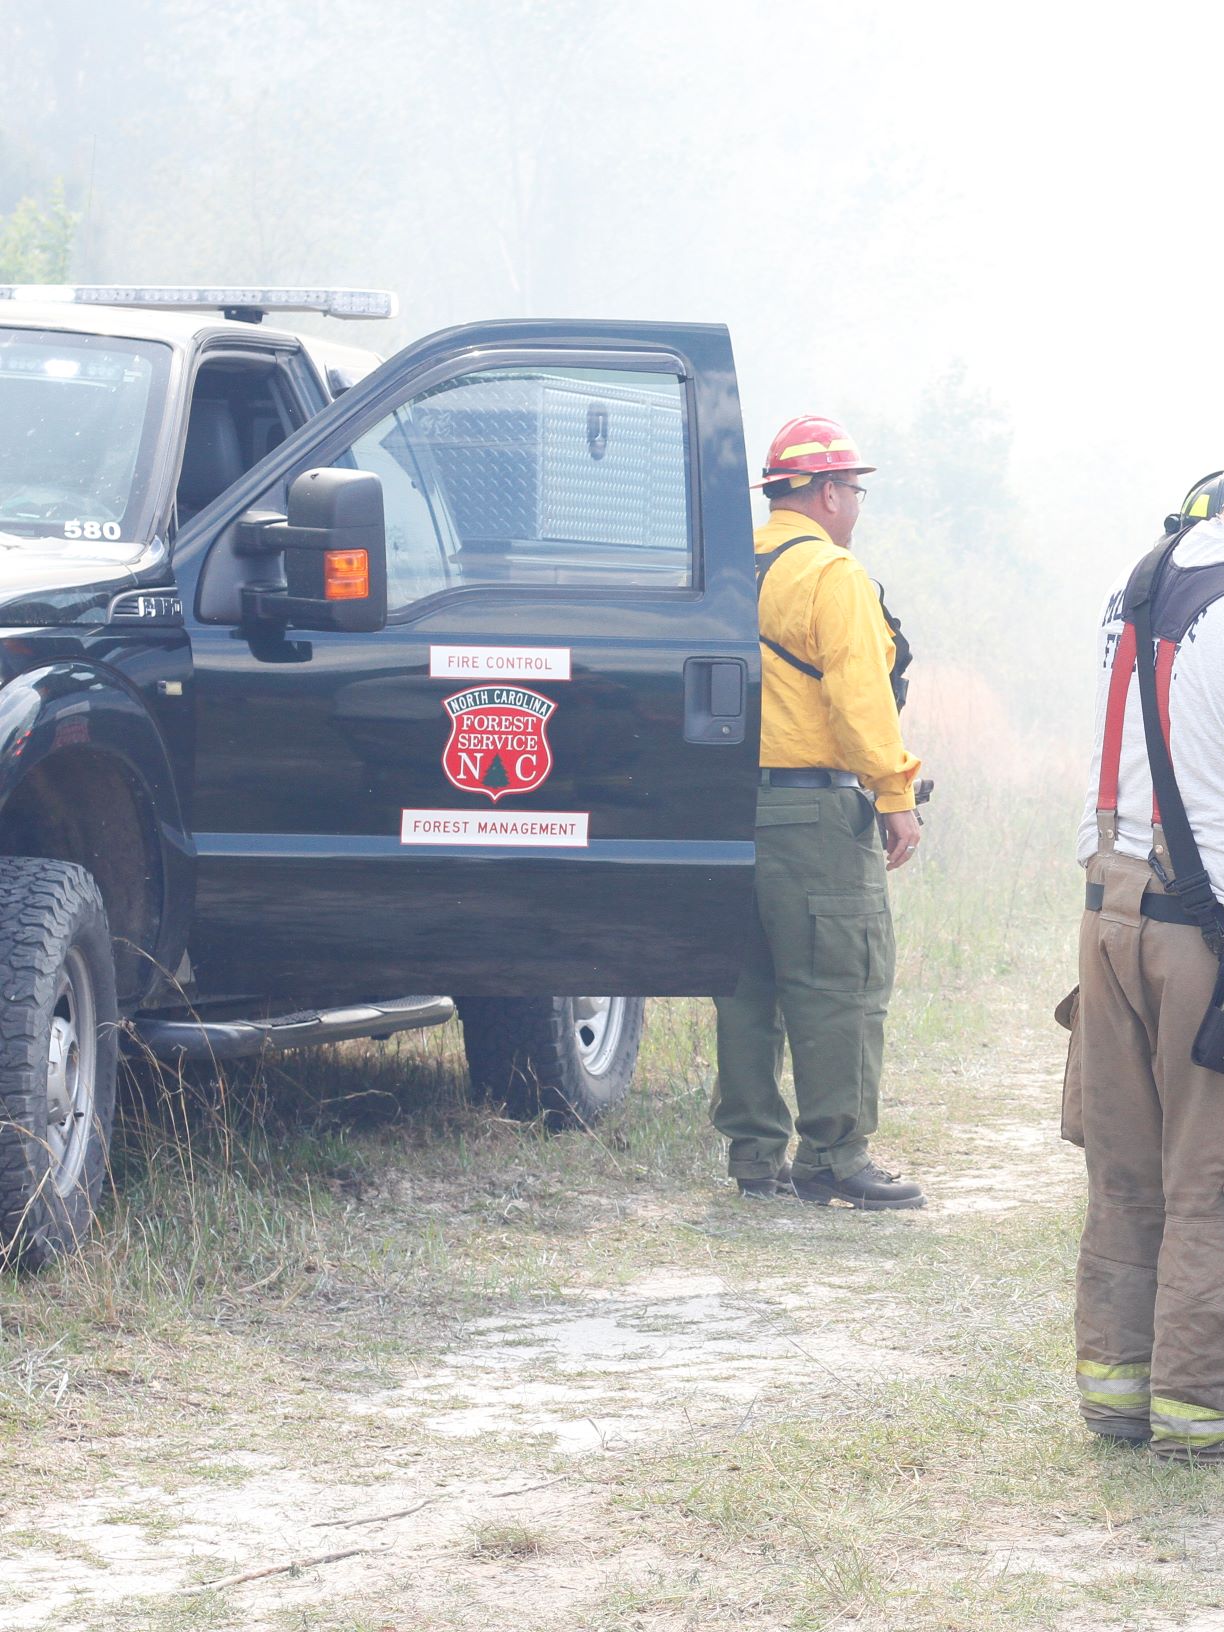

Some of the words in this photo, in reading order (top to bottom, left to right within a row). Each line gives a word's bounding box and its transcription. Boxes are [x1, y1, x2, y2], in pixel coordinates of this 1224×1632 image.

[64, 520, 121, 540] 580
[448, 656, 480, 669] FIRE
[486, 656, 552, 670] CONTROL
[450, 690, 489, 713] NORTH
[494, 689, 548, 716] CAROLINA
[461, 715, 537, 732] FOREST
[457, 734, 538, 751] SERVICE
[456, 752, 484, 780] N
[515, 753, 537, 781] C
[413, 820, 470, 834] FOREST
[477, 822, 577, 836] MANAGEMENT
